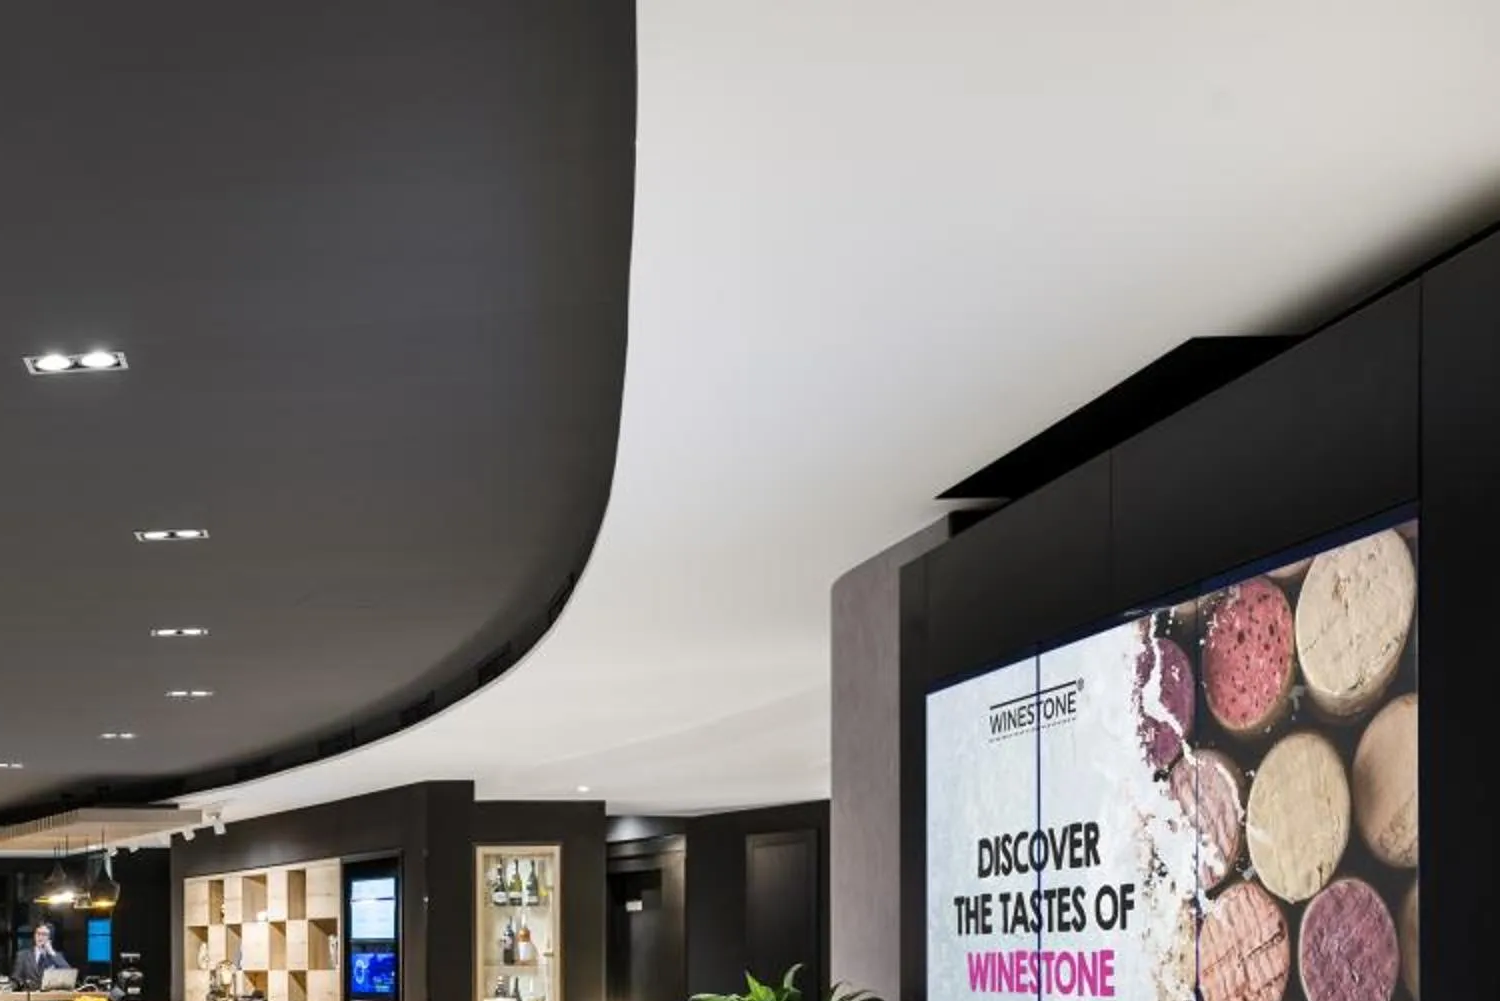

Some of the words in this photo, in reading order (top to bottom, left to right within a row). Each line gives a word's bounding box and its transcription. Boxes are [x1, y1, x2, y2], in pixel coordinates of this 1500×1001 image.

[989, 691, 1077, 735] WINESTONE
[977, 821, 1101, 878] DISCOVER
[953, 894, 993, 936] THE
[999, 886, 1087, 935] TASTES
[1095, 883, 1136, 931] OF
[966, 950, 1115, 997] WINESTONE
